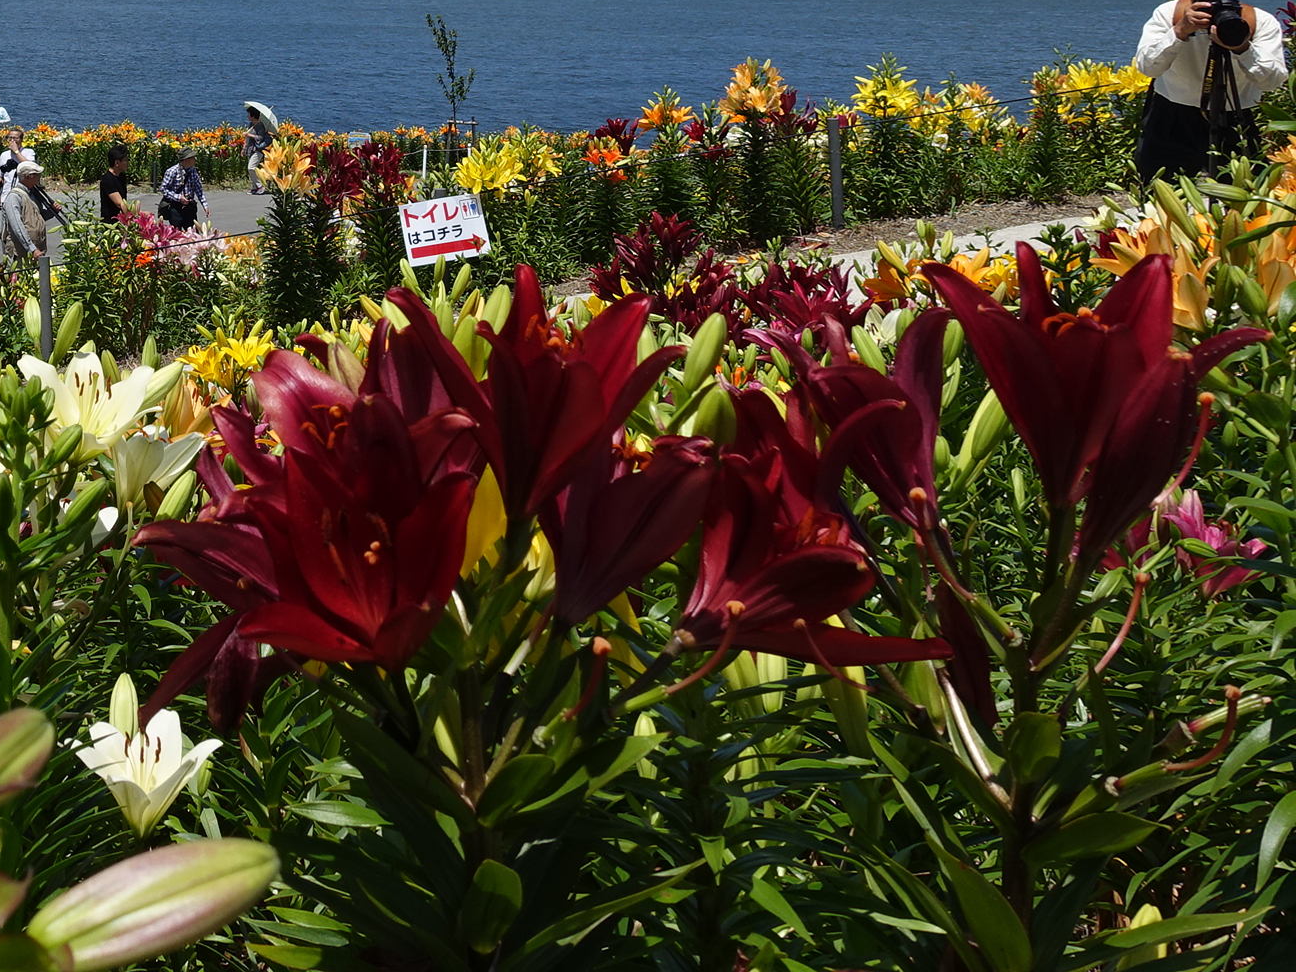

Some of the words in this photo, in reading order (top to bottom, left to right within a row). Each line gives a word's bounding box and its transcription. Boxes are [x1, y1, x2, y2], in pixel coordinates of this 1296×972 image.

[403, 202, 459, 228] トイレ
[407, 224, 464, 246] はコチラ
